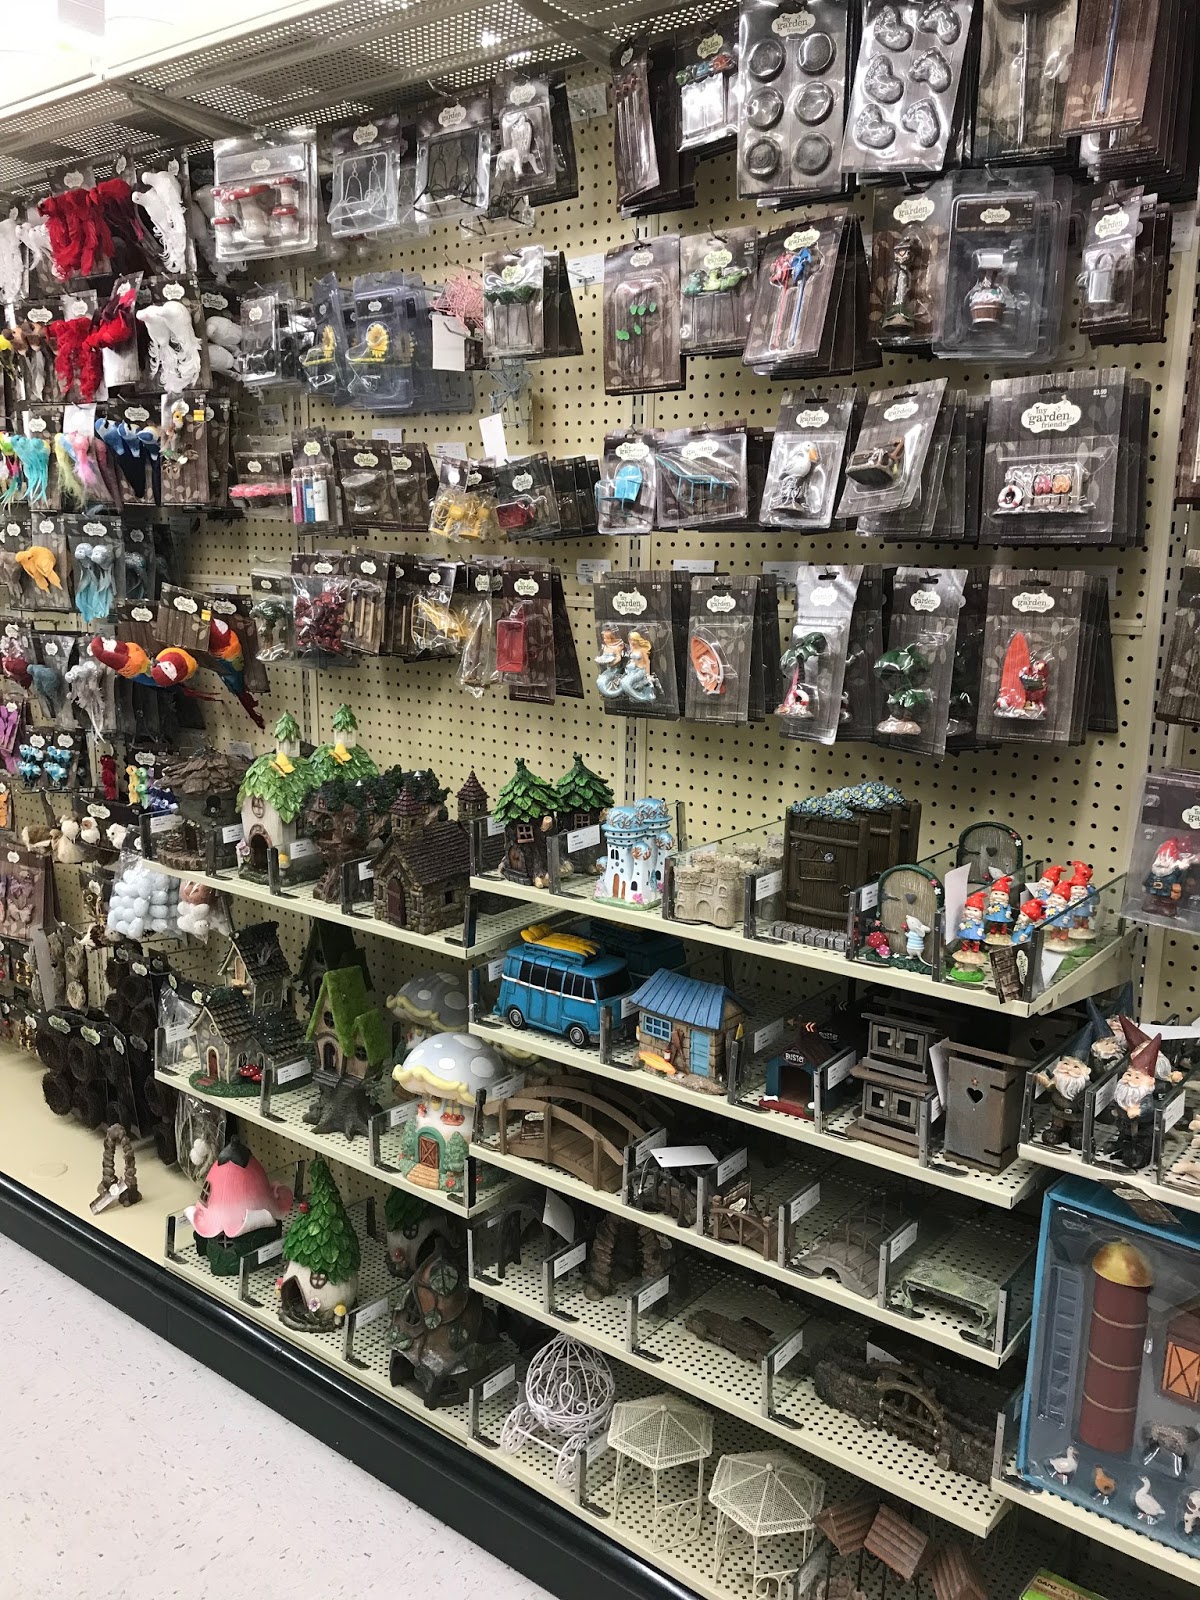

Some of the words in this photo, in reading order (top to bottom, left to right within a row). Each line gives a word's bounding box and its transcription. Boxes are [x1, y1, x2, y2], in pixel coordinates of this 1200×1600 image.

[776, 19, 808, 30] garden
[898, 206, 928, 218] garden
[1099, 220, 1123, 232] garden
[788, 236, 814, 246] garden
[707, 255, 728, 264] garden
[888, 408, 913, 418] garden
[800, 414, 824, 424] garden
[1028, 412, 1070, 425] garden
[616, 599, 641, 608] garden
[1018, 599, 1047, 607] garden
